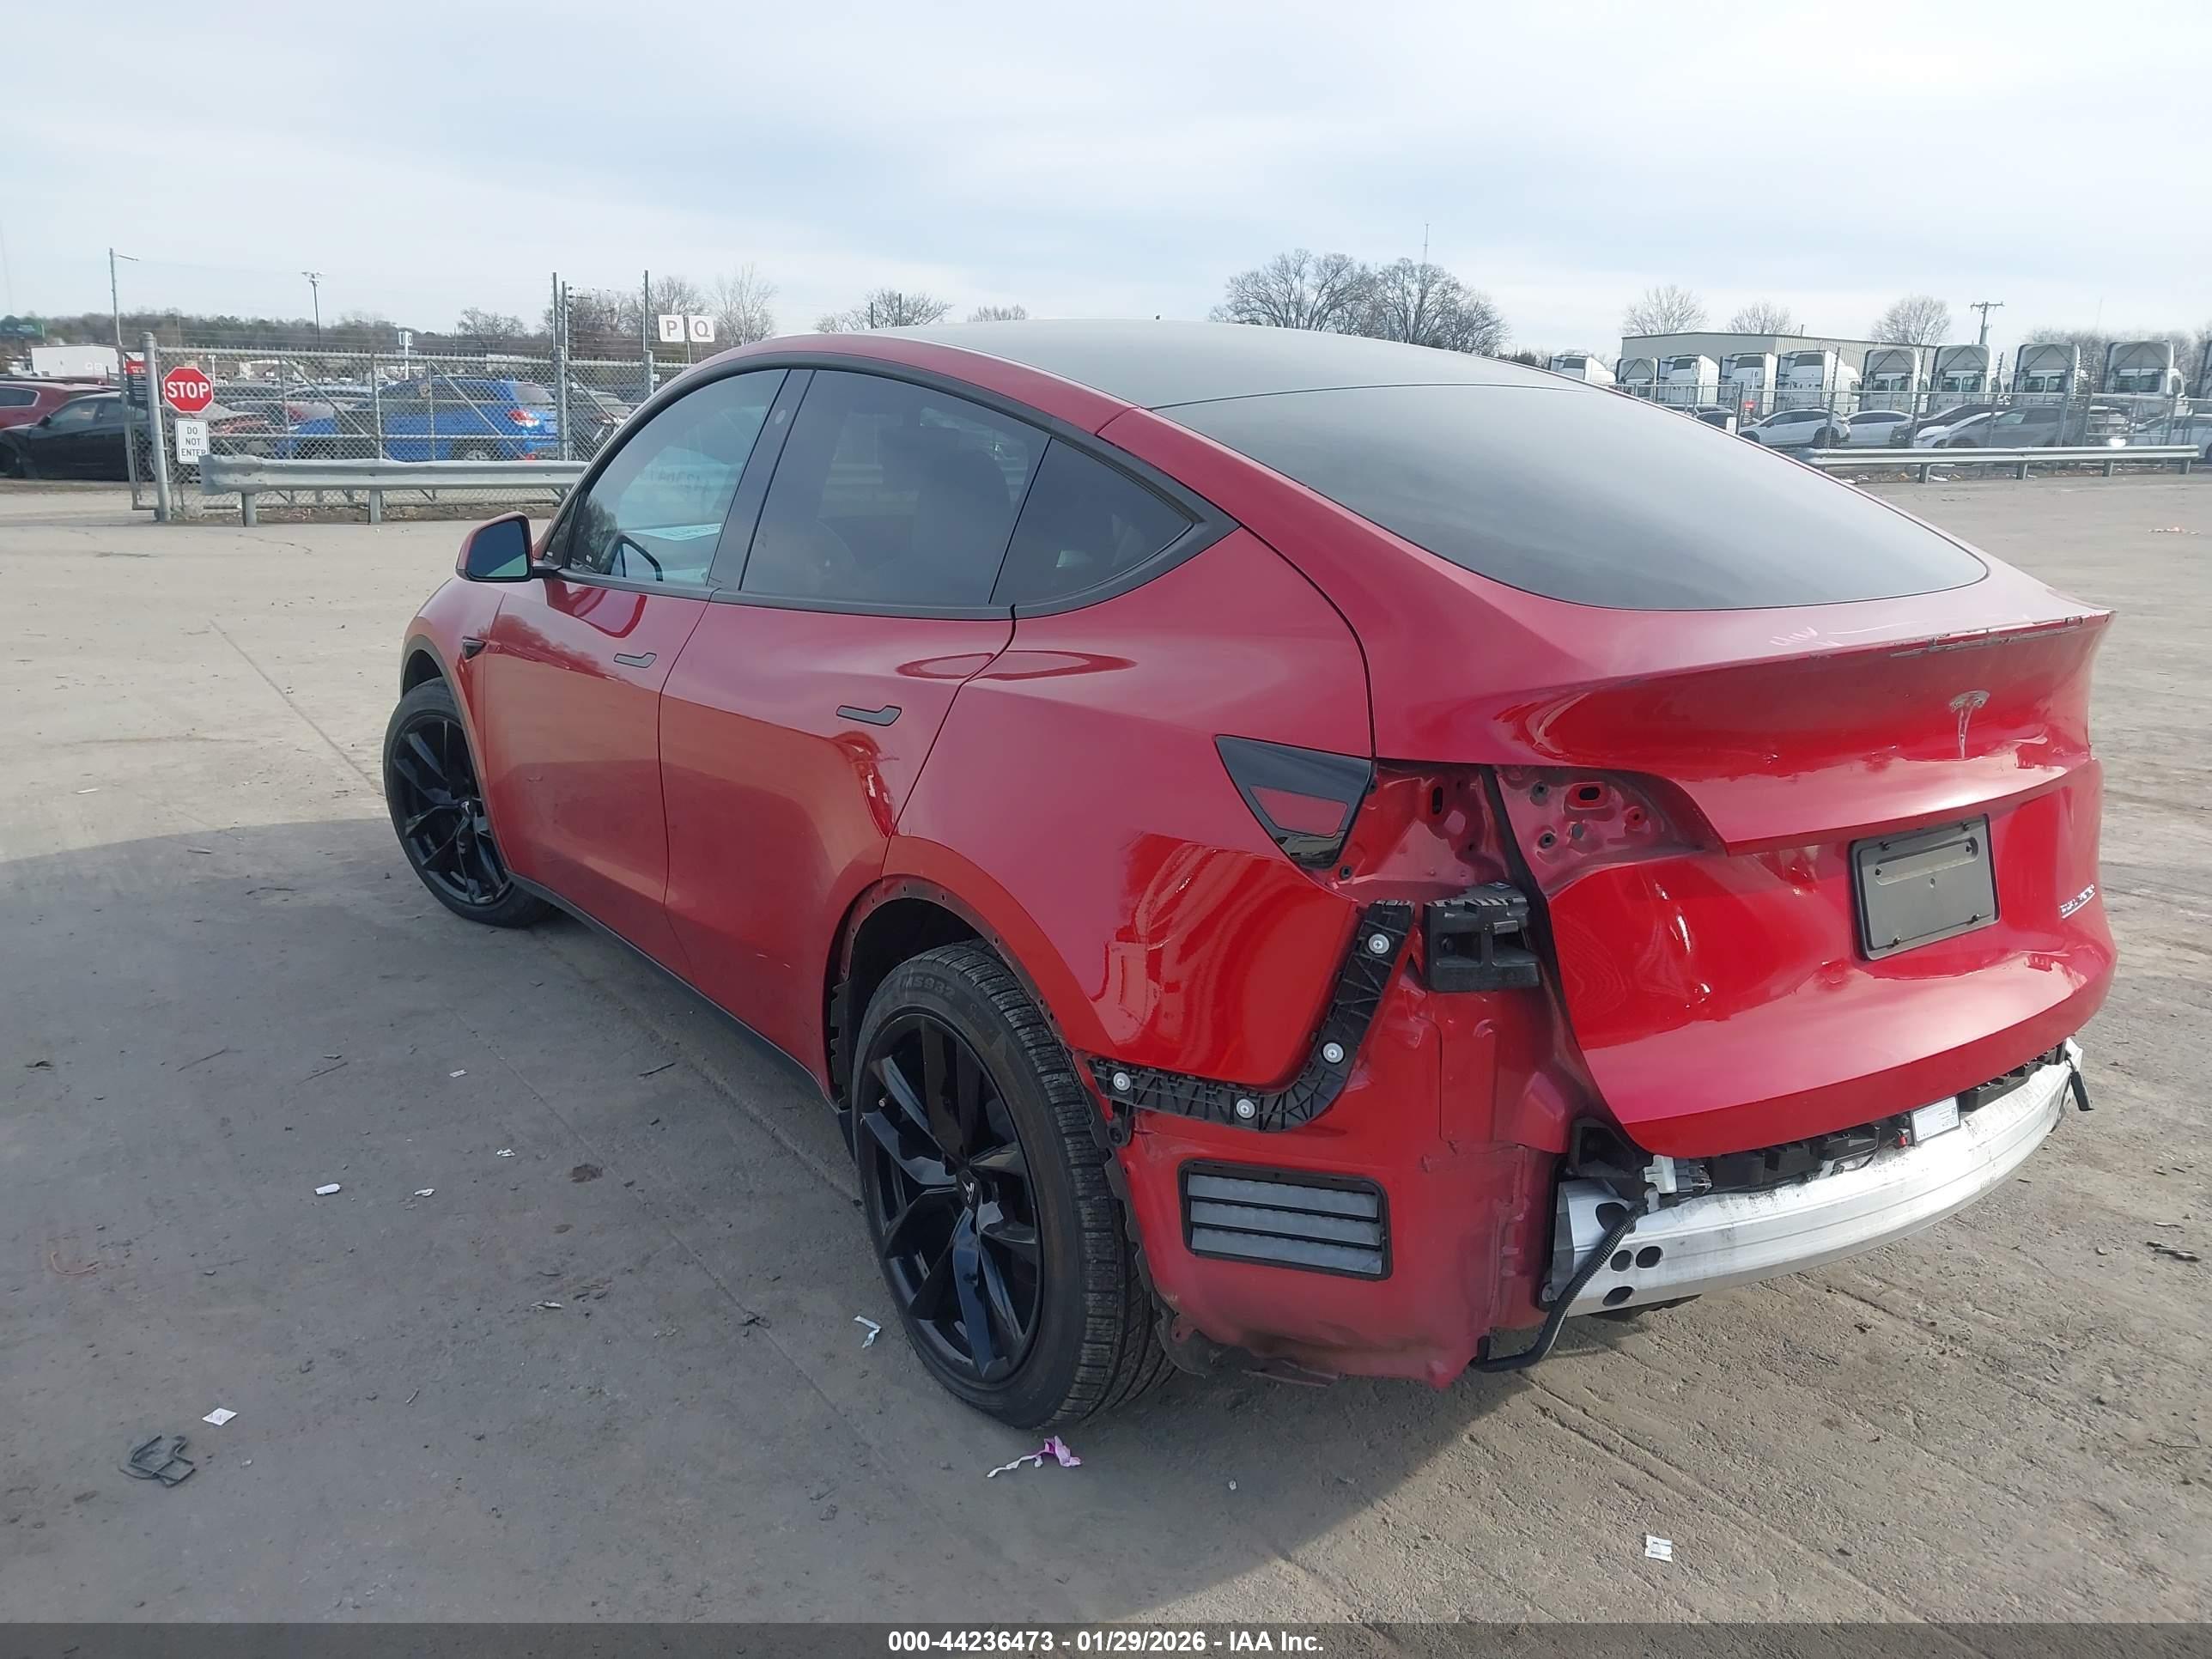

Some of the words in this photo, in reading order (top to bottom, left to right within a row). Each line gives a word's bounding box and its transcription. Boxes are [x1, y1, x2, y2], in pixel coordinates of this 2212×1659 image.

[666, 320, 678, 337] P
[695, 320, 710, 337] Q
[167, 381, 210, 398] STOP
